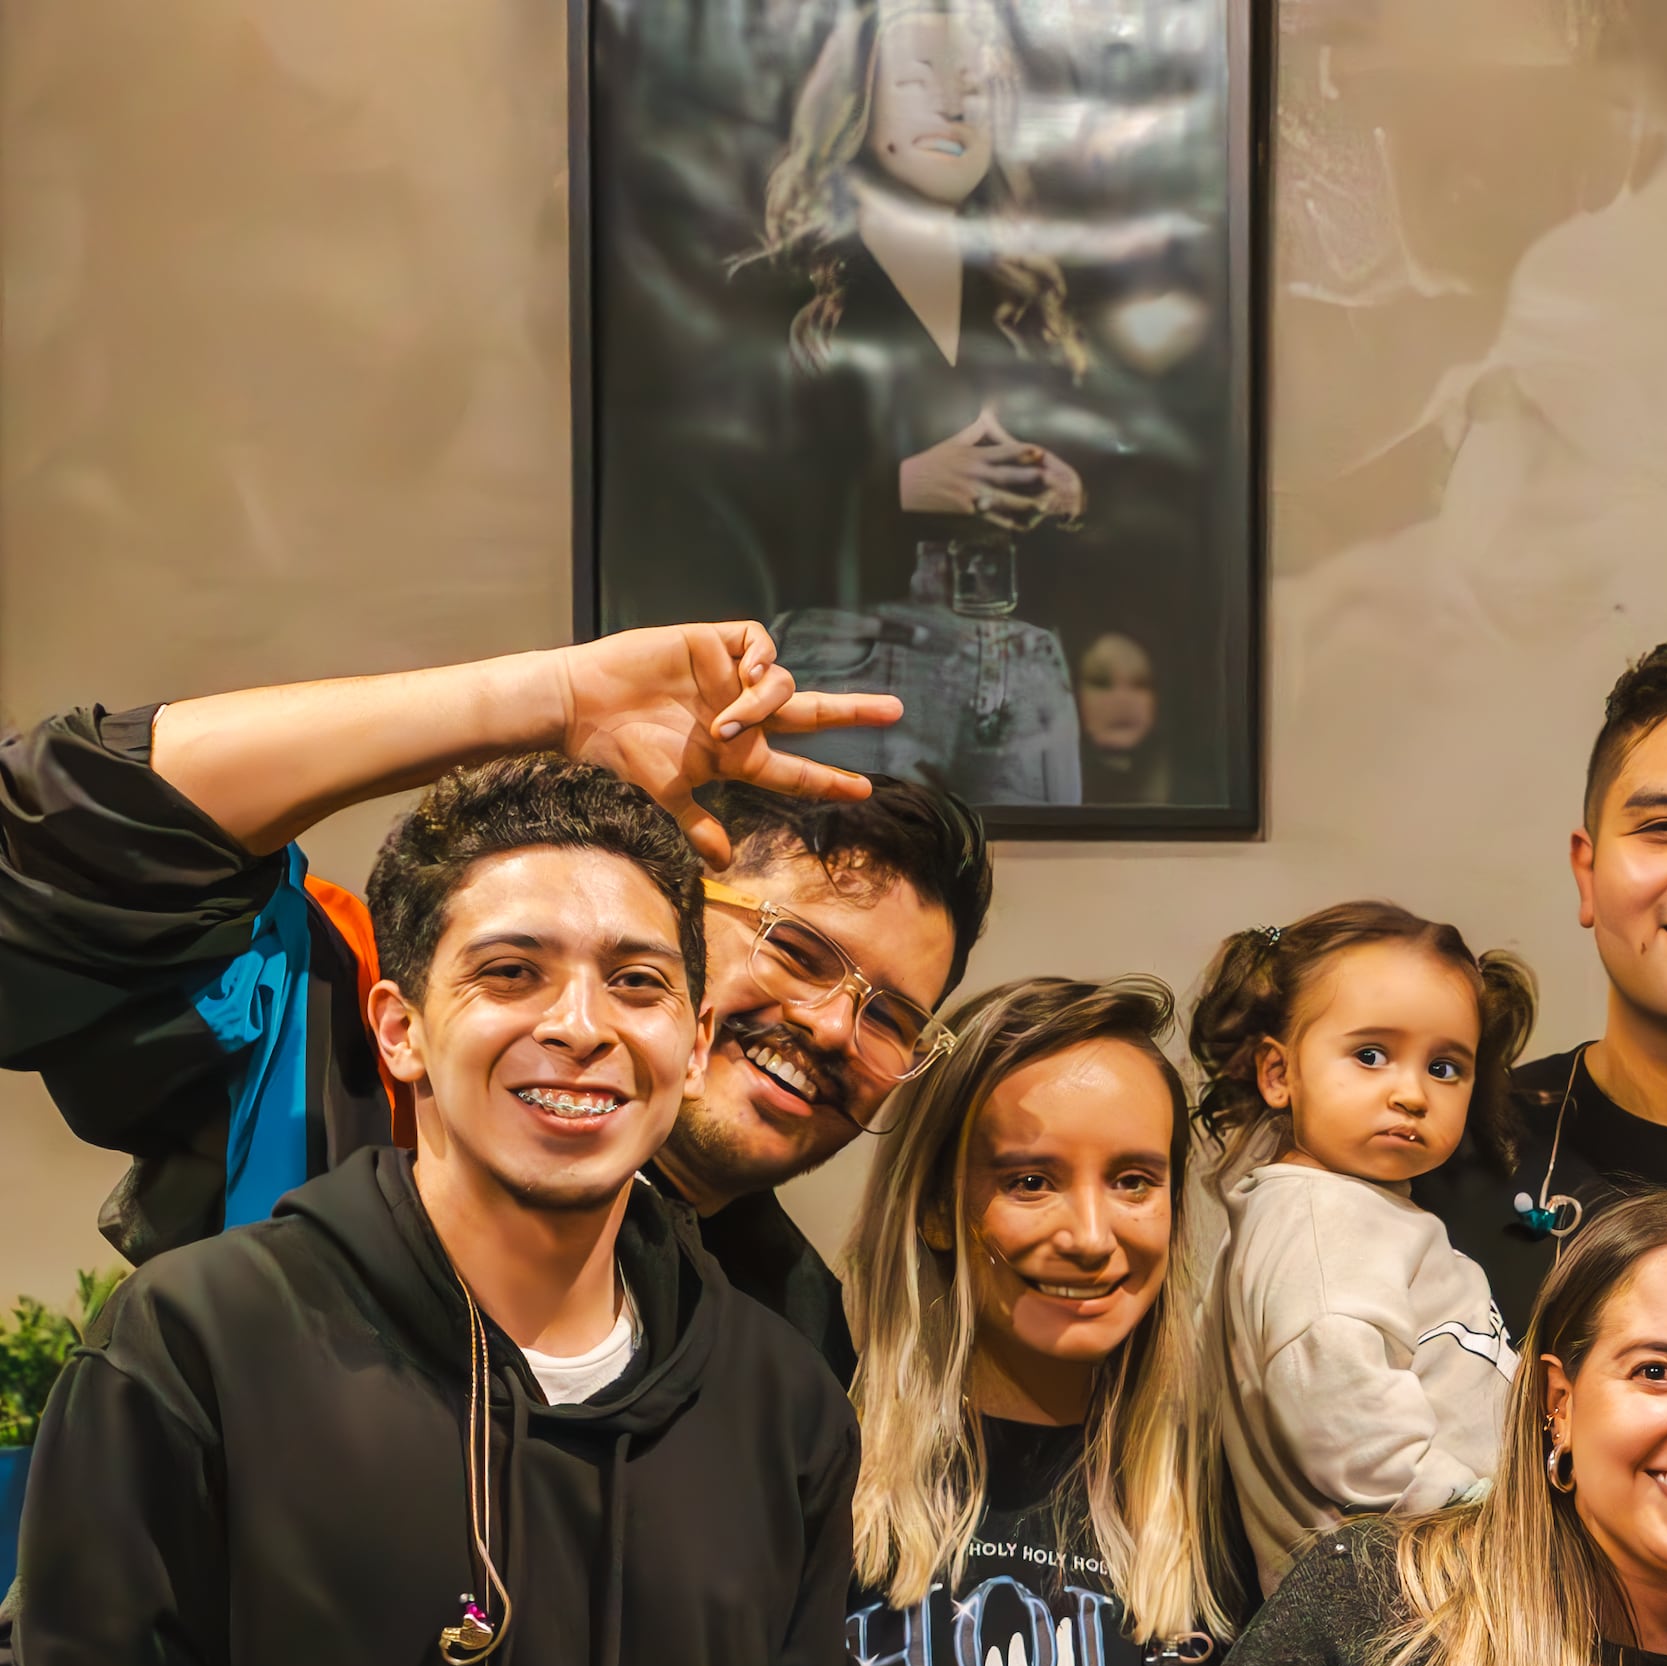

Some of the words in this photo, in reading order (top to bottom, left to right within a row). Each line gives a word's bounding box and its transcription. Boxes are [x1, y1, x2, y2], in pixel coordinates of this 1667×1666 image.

[969, 1542, 1018, 1557] HOLY
[1022, 1546, 1067, 1568] HOLY
[1073, 1555, 1112, 1576] HOL
